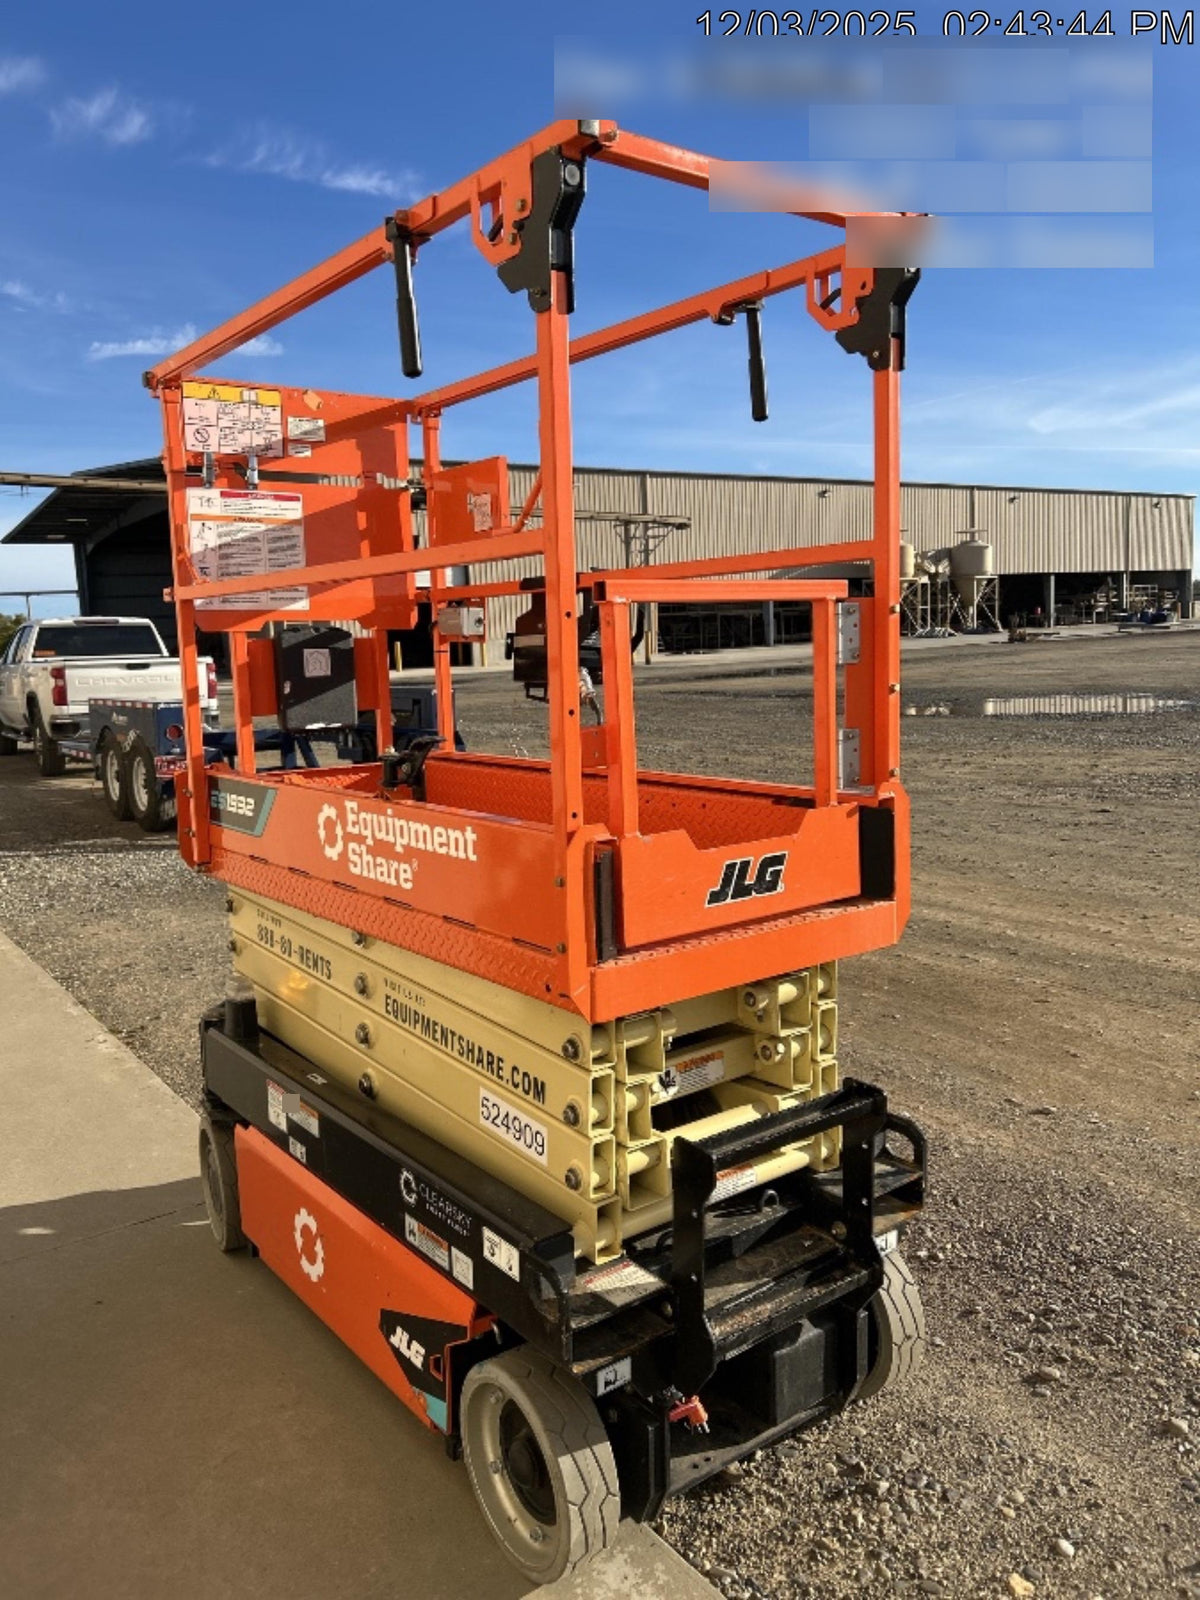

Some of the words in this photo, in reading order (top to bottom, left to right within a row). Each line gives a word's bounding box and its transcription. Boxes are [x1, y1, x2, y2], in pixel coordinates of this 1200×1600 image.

[75, 675, 181, 687] CHEVROL
[344, 800, 477, 861] Equipment
[705, 851, 788, 907] JLG
[385, 993, 546, 1105] EQUIPMENTSHARE.COM
[481, 1096, 545, 1156] 524909
[390, 1325, 426, 1371] JLG
